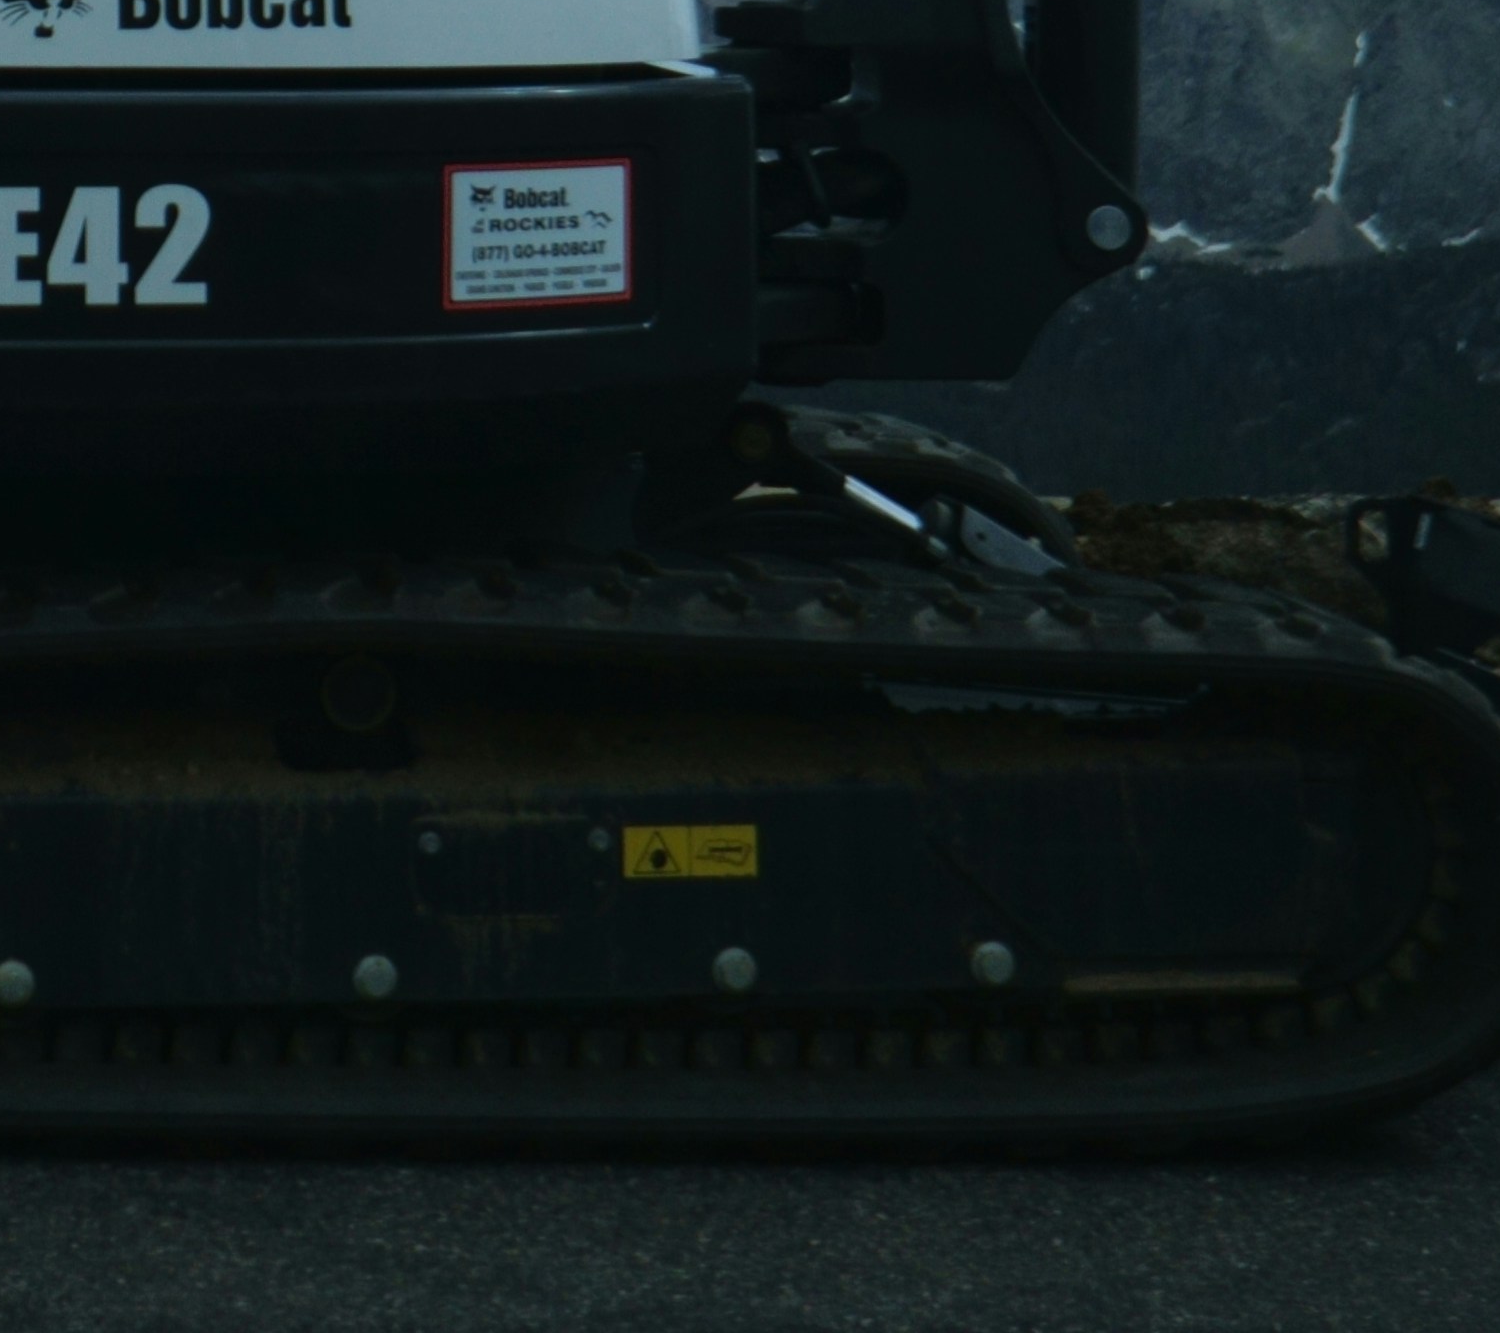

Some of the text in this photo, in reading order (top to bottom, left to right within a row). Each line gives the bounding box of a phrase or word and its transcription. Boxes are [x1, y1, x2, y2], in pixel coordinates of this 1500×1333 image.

[504, 187, 567, 209] Bobcat
[489, 216, 580, 232] ROCKIES
[471, 241, 606, 263] (877) GO-4-BOBCAT
